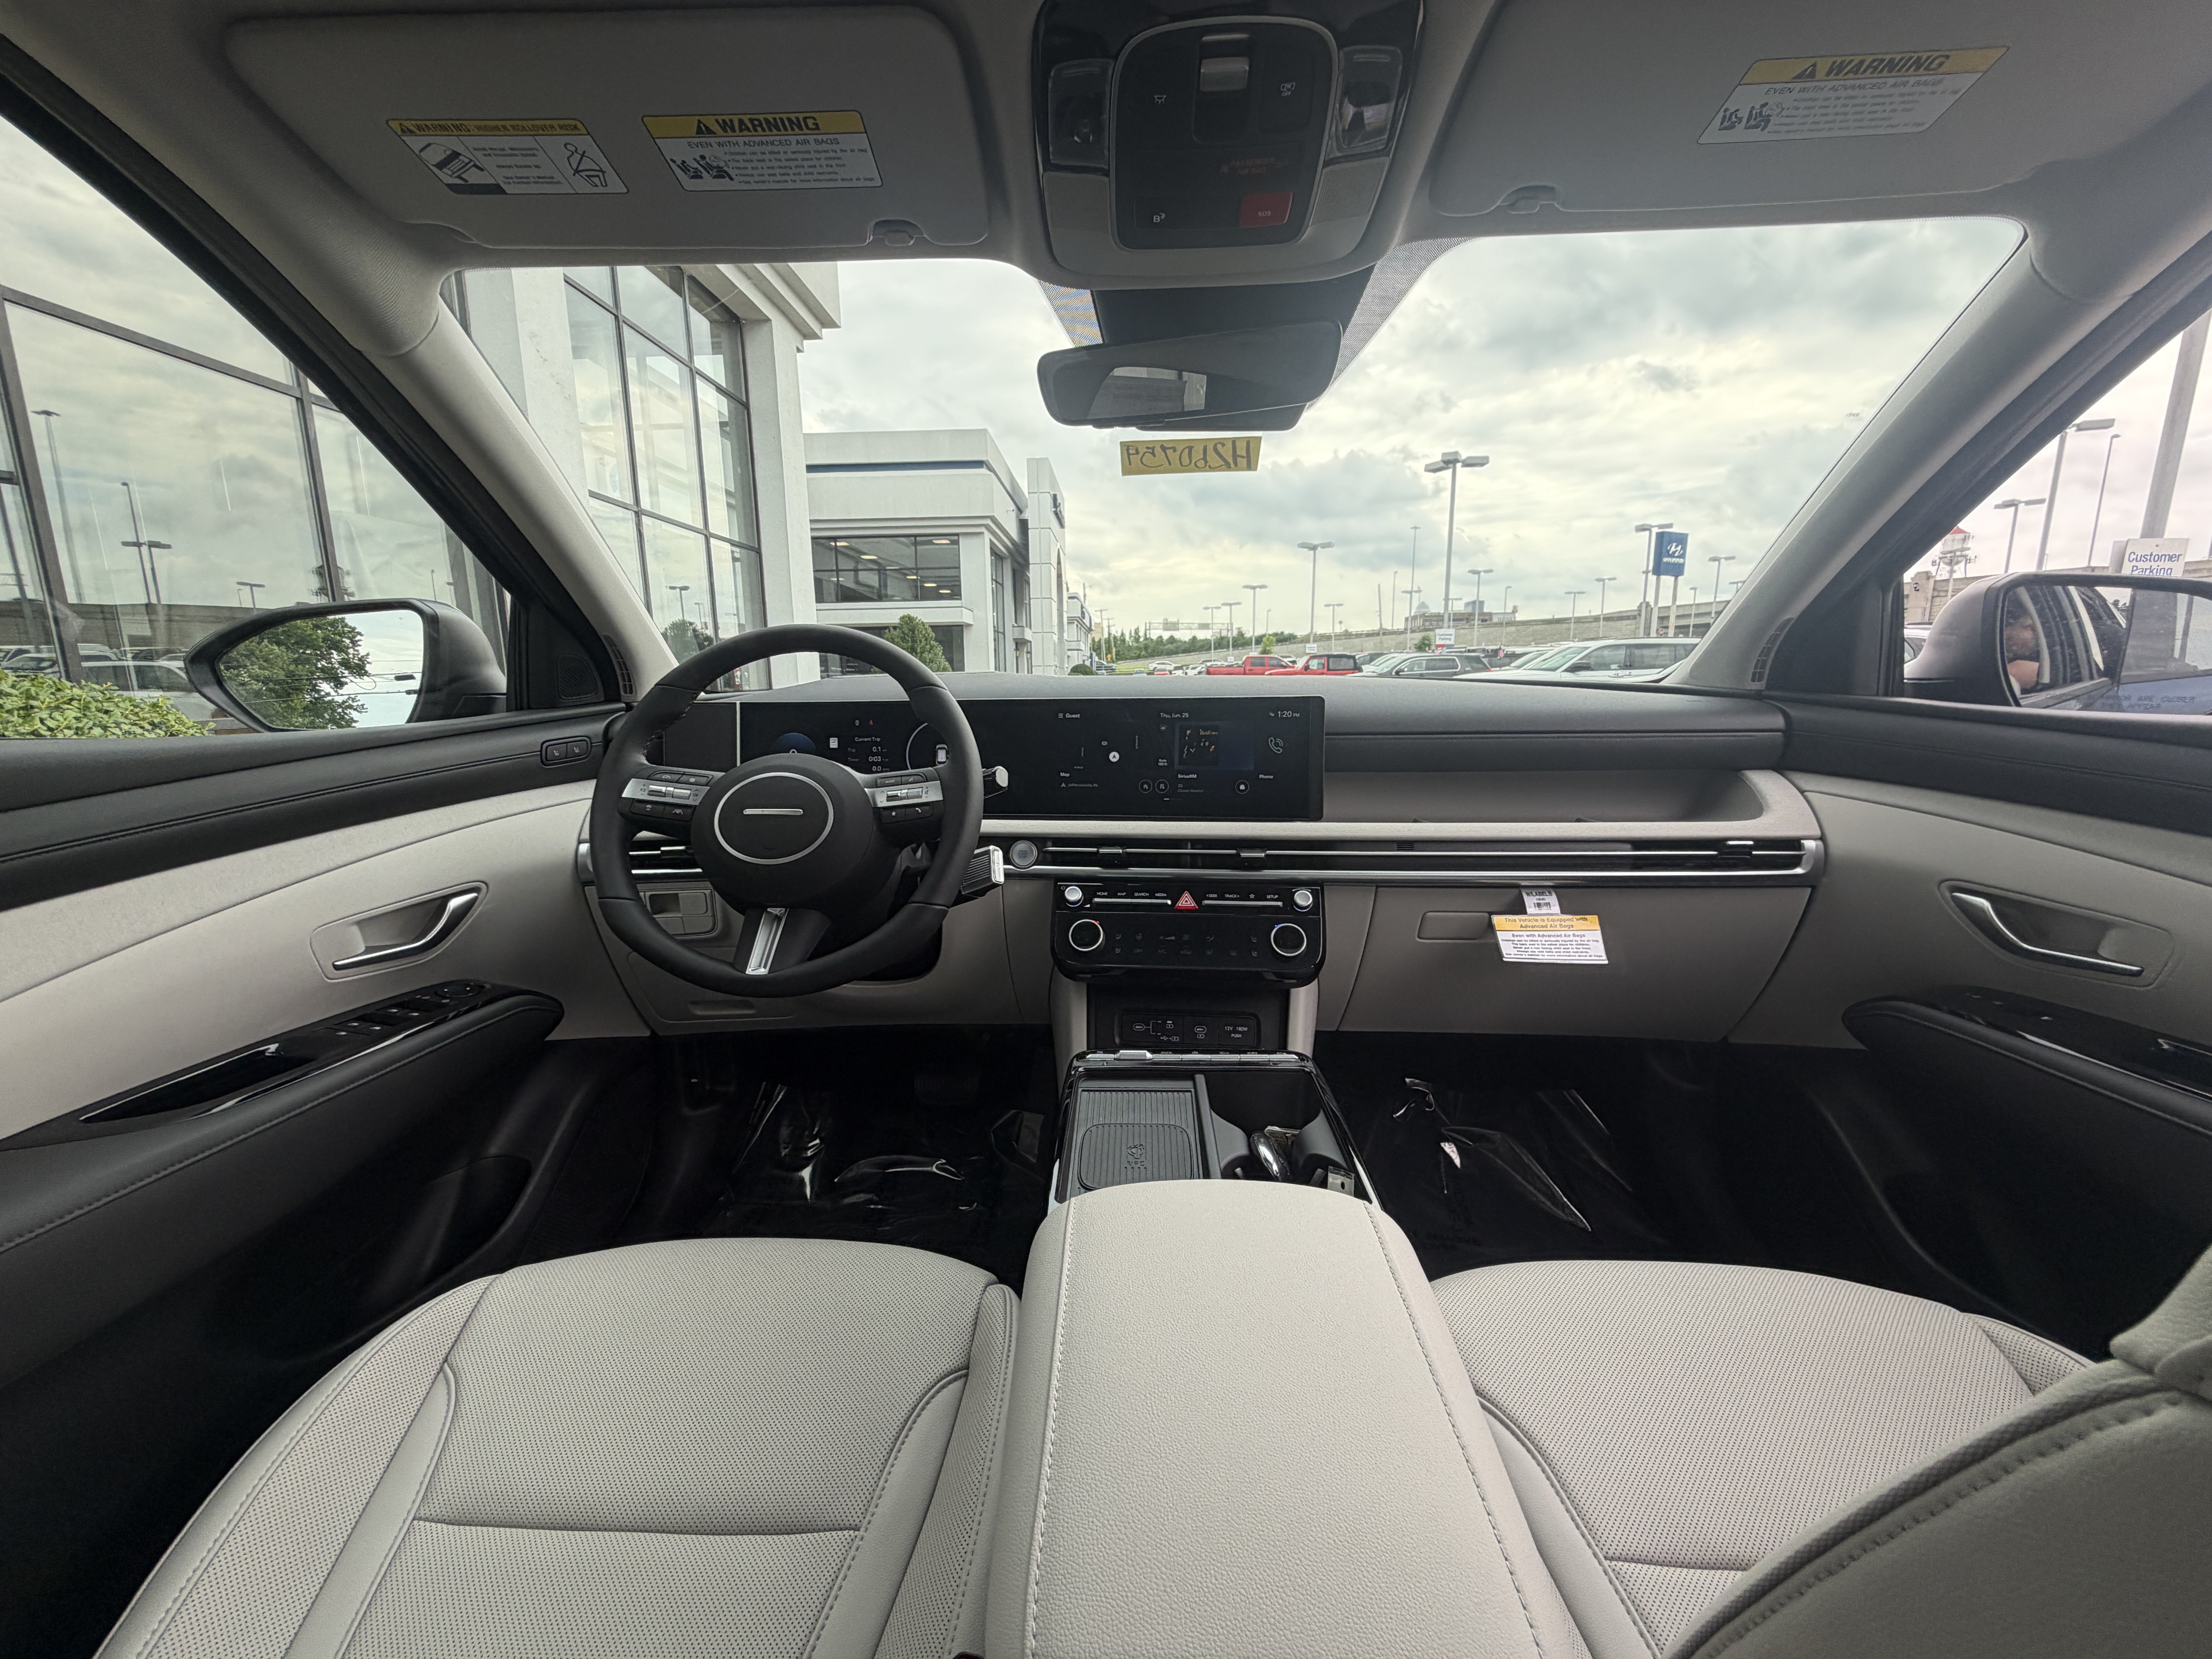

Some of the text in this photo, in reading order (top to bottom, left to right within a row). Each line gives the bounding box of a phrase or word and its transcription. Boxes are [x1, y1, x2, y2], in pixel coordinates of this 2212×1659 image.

[1825, 55, 1950, 77] WARNING
[1828, 82, 1887, 91] ADVANCED
[714, 116, 821, 133] WARNING
[743, 139, 791, 148] ADVANCED
[813, 137, 840, 146] BAGS
[2128, 551, 2183, 562] Customer
